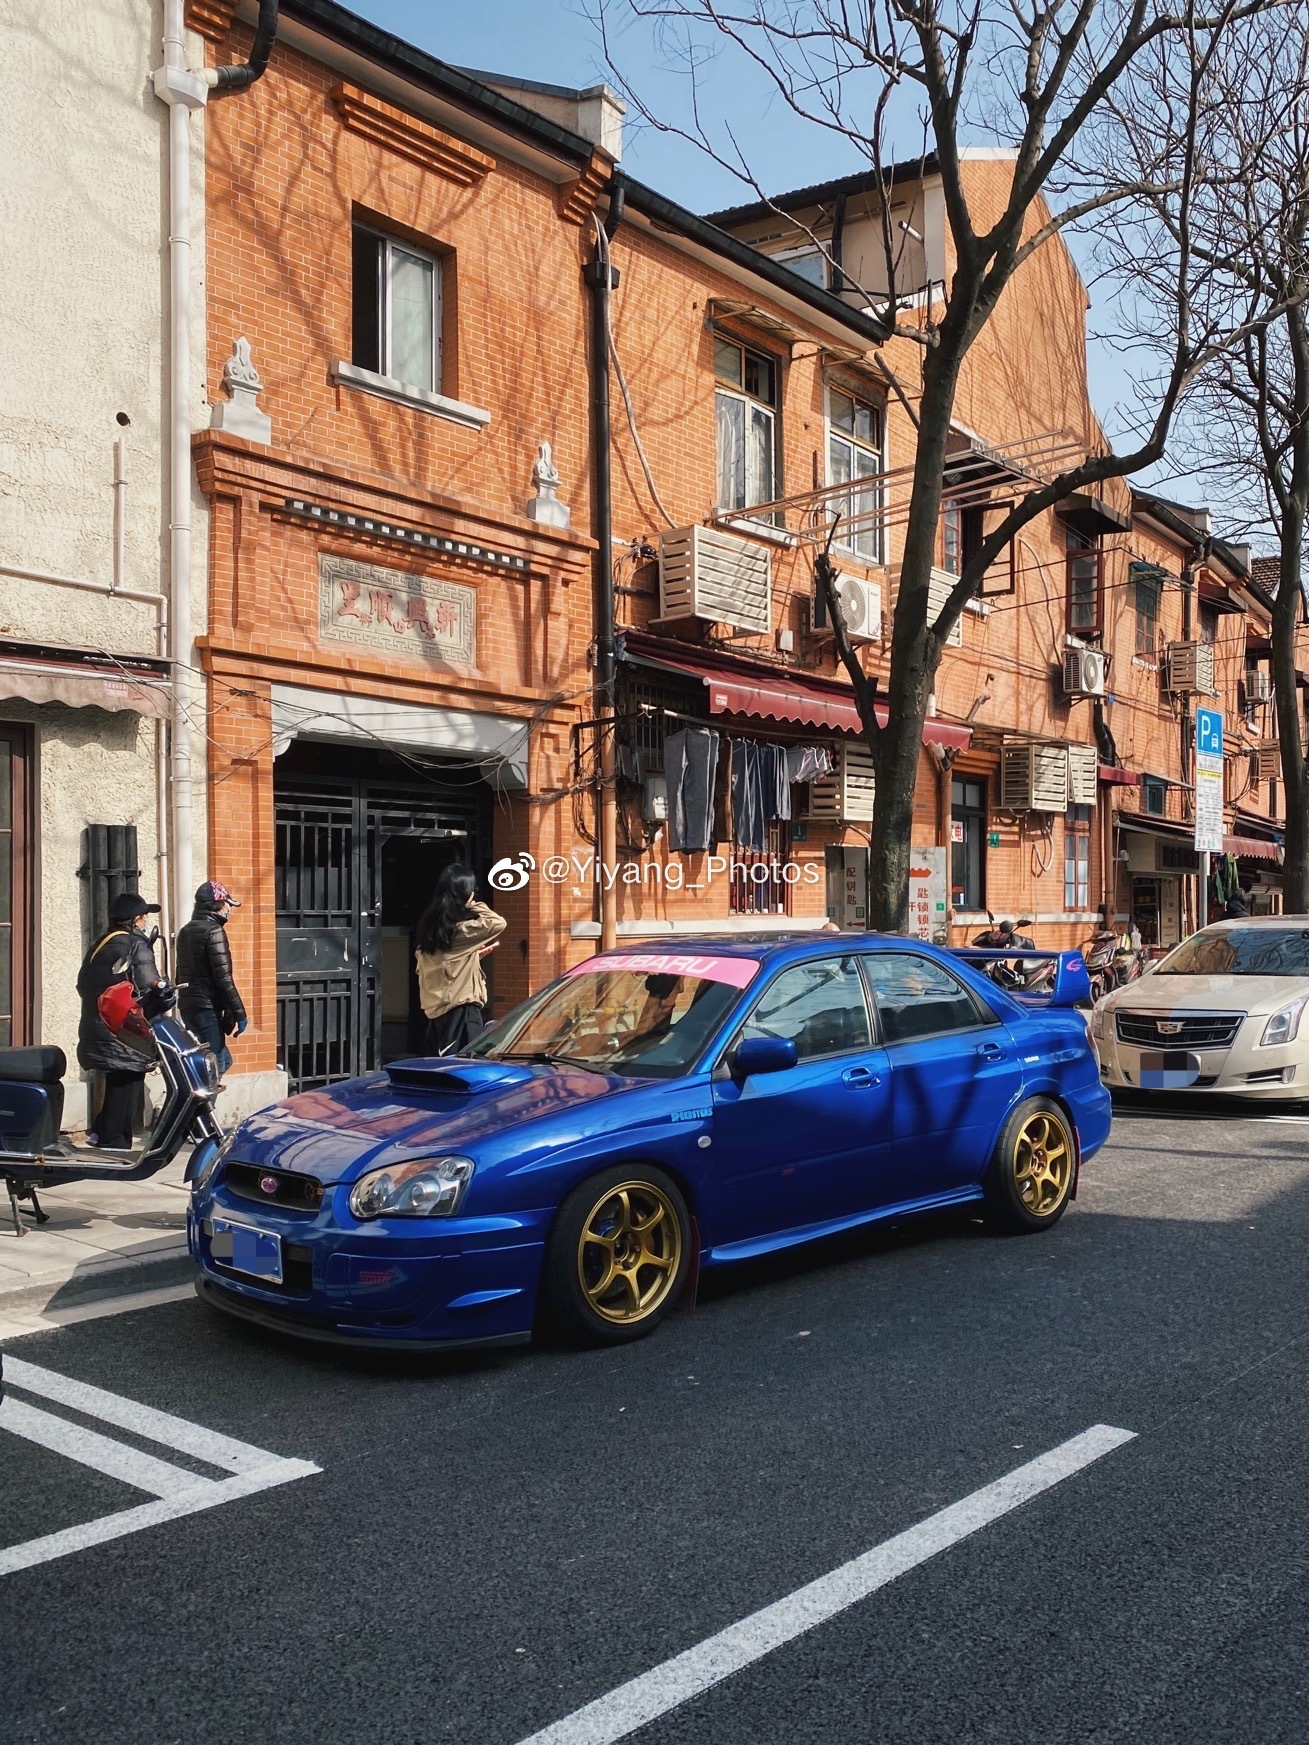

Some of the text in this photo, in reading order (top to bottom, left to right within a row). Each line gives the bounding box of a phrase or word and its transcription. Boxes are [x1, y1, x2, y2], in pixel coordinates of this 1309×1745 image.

[1201, 715, 1211, 747] P
[845, 866, 857, 906] 配钥匙
[592, 954, 718, 974] SUBARU
